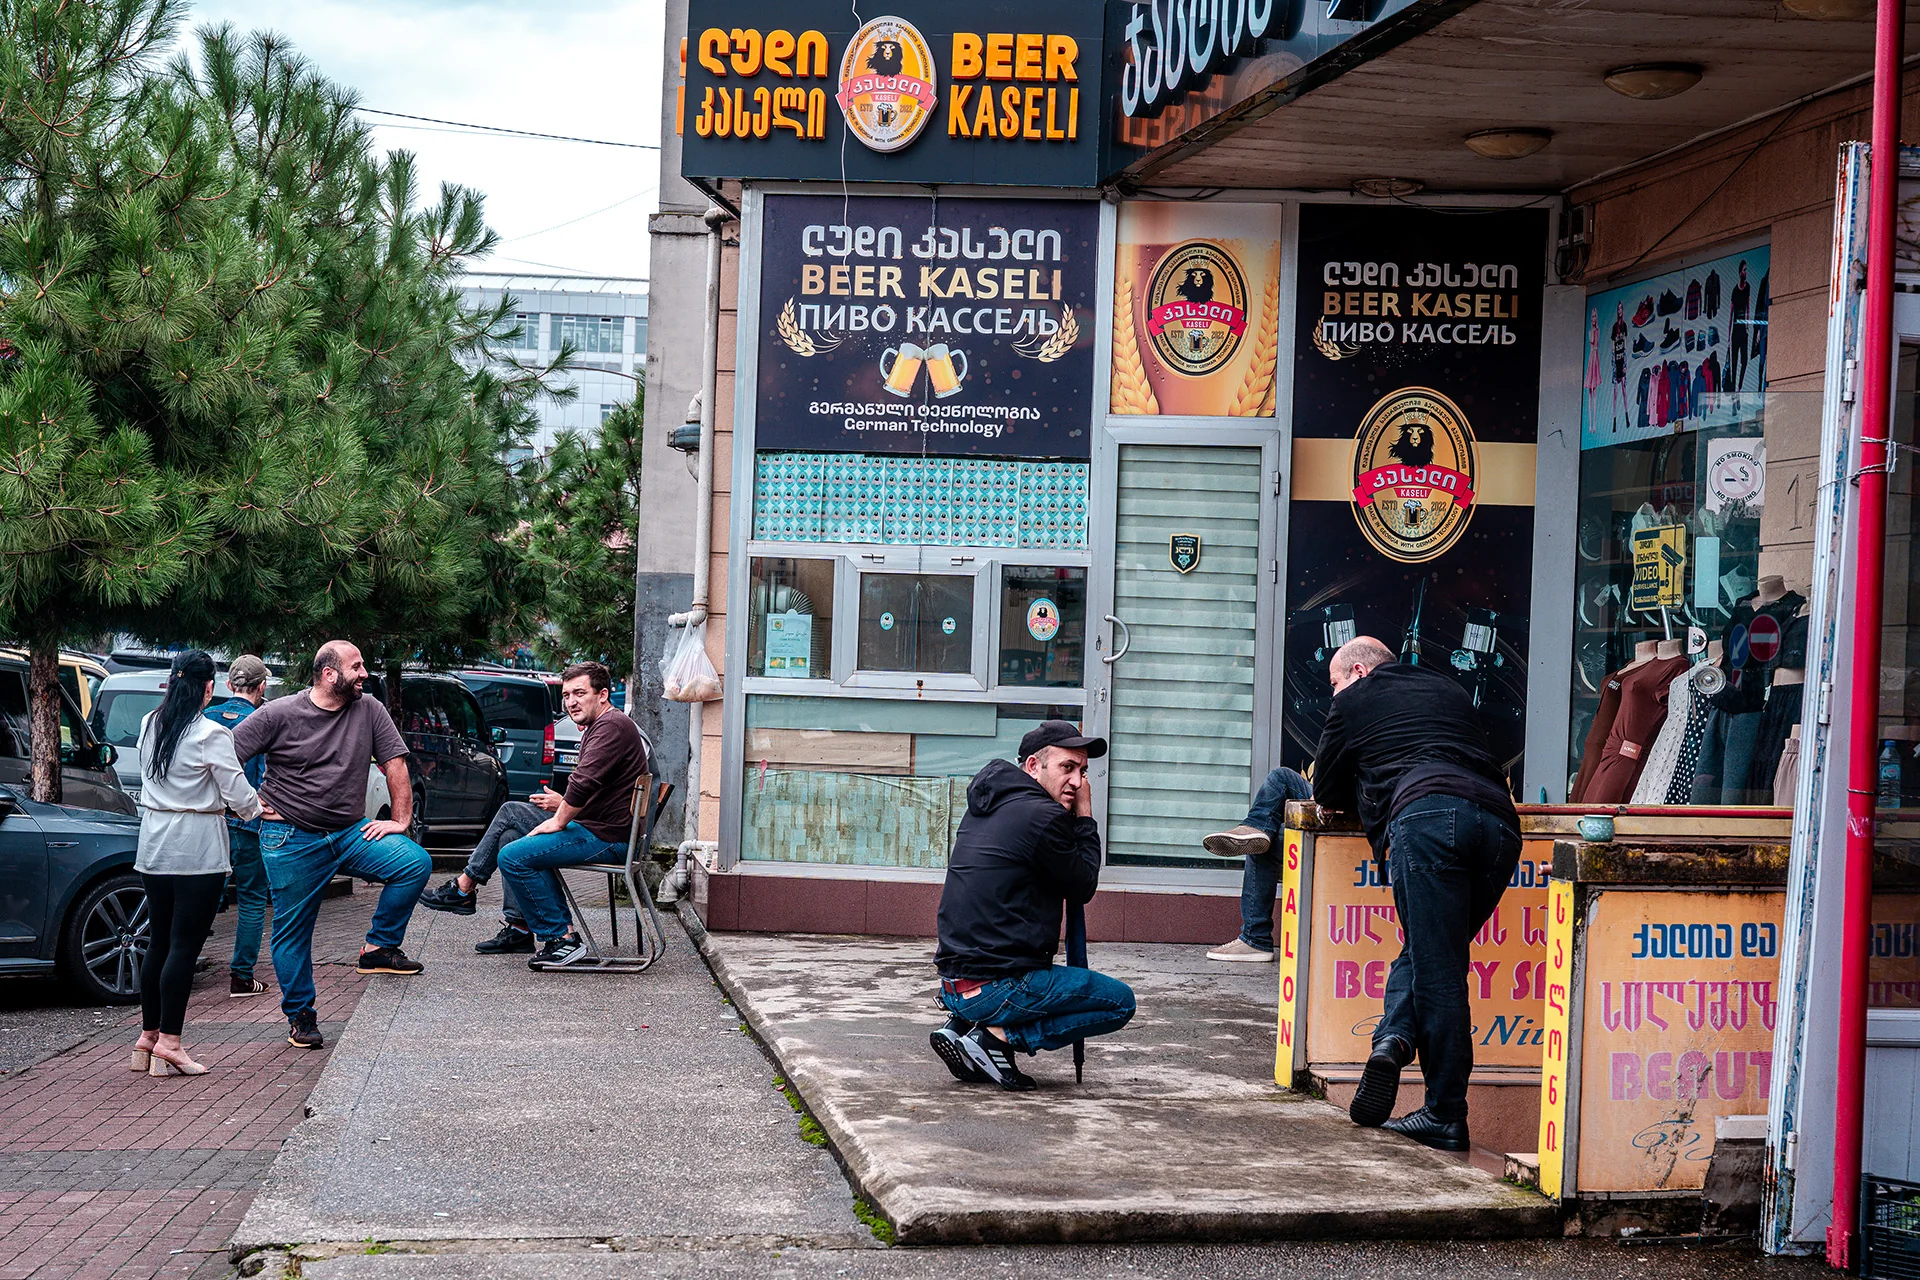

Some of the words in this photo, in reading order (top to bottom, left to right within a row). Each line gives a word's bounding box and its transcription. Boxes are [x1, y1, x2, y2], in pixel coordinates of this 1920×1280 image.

[698, 27, 829, 78] ლუდი
[951, 32, 1079, 82] BEER
[695, 86, 827, 140] კასელი
[948, 84, 1079, 141] KASELI
[802, 225, 903, 259] ლუდი
[911, 226, 1061, 261] კასელი
[801, 264, 906, 298] BEER
[919, 266, 1062, 300] KASELI
[1323, 261, 1399, 287] ლუდი
[1406, 262, 1518, 289] კასელი
[799, 304, 896, 332] ПИВО
[906, 306, 1059, 335] КАССЕЛЬ
[1323, 292, 1401, 317] BEER
[1411, 292, 1519, 318] KASELI
[1322, 322, 1395, 343] ПИВО
[1402, 322, 1517, 346] КАССЕЛЬ
[809, 401, 914, 417] გერმანული
[917, 403, 1041, 420] ტექნოლოგია
[844, 417, 908, 432] German
[911, 419, 1004, 438] Technology
[1400, 489, 1427, 497] KASELI
[1431, 501, 1447, 512] 2022
[1367, 505, 1376, 521] MADE
[1380, 527, 1399, 545] GEORGIA
[1415, 537, 1438, 548] GERMAN
[1438, 507, 1459, 537] TECHNOLOGY
[1280, 843, 1298, 1048] SALON
[1631, 923, 1735, 960] ქალთა
[1741, 922, 1778, 959] და
[1599, 977, 1778, 1033] სილამაზ
[1610, 1051, 1773, 1101] BEAUT
